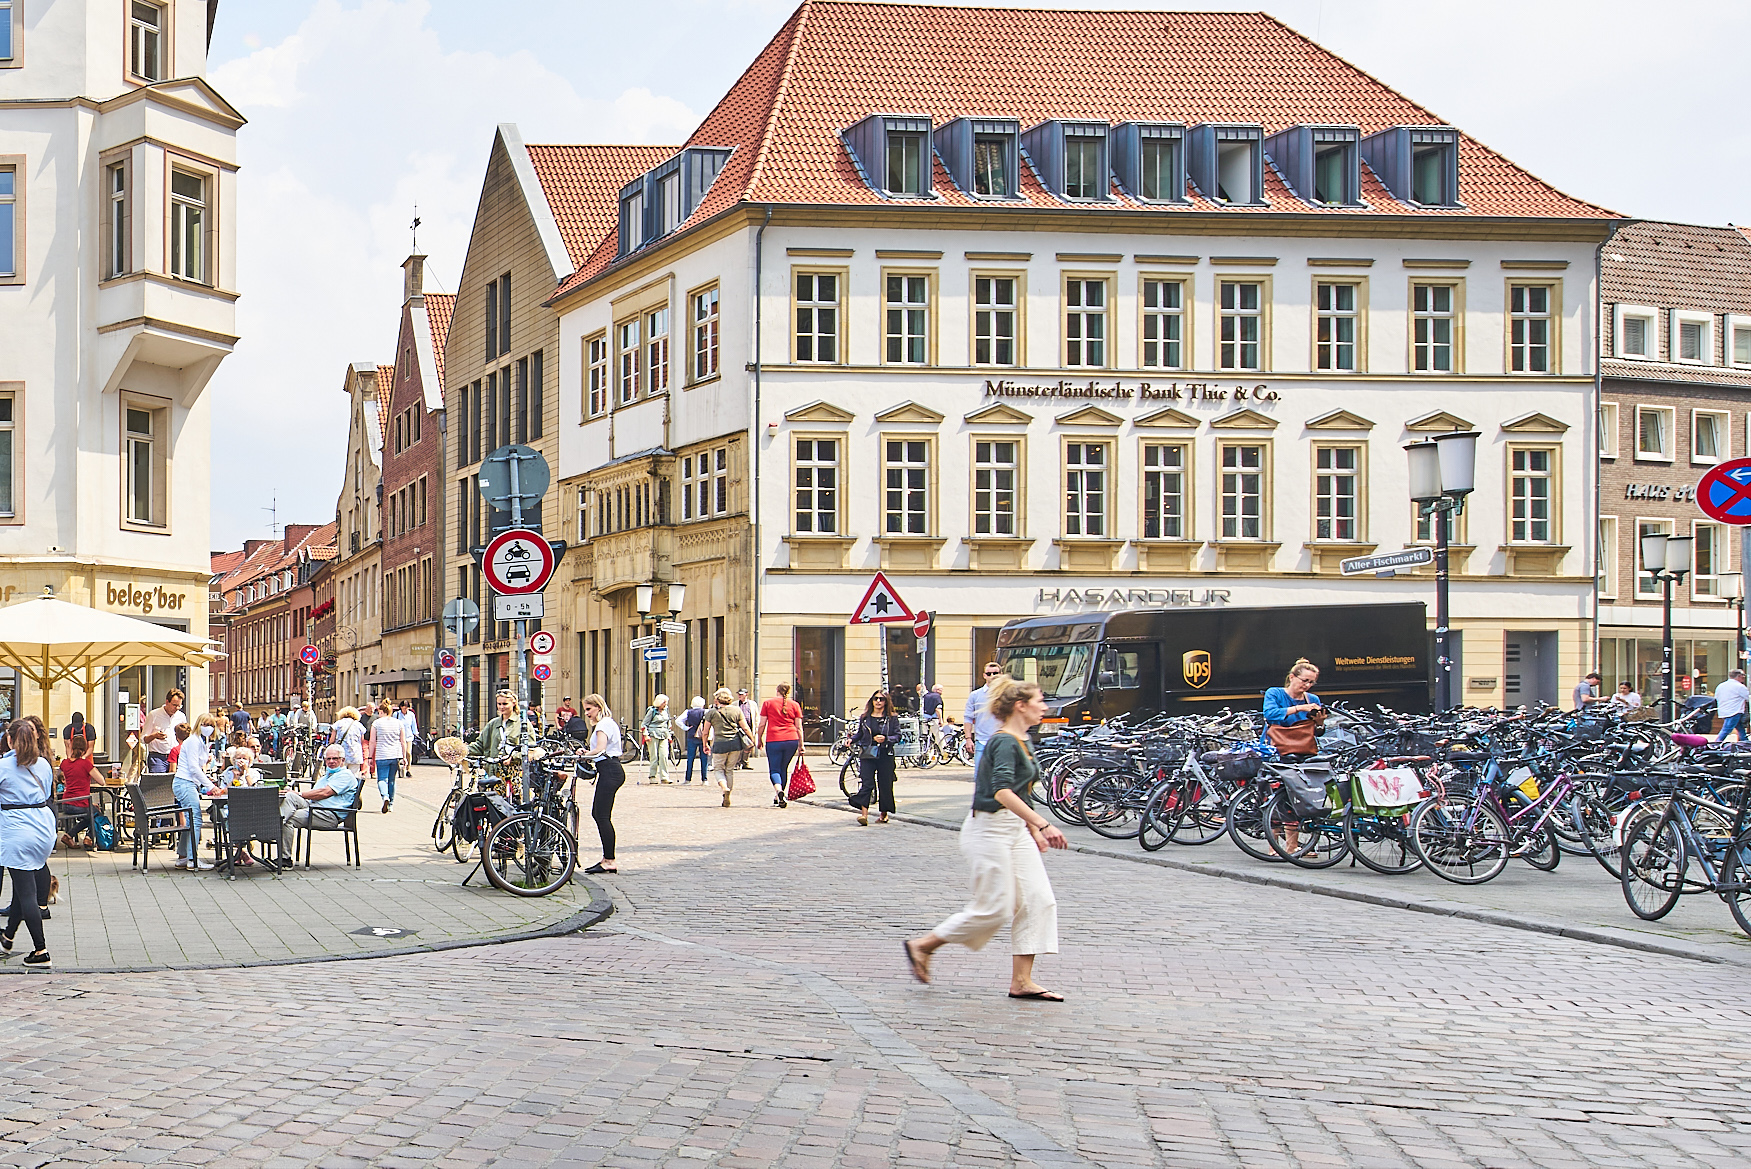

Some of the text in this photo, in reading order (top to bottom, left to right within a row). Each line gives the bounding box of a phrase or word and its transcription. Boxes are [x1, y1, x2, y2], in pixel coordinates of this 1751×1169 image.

[985, 380, 1282, 402] Münsterländische Bank Thie & Co.
[1626, 483, 1672, 498] HAUS
[1373, 551, 1423, 567] Fischmarkt
[1039, 588, 1232, 604] HASARDEUR
[1334, 655, 1415, 666] Weltweite Dienstleistungen
[1186, 661, 1209, 683] ups
